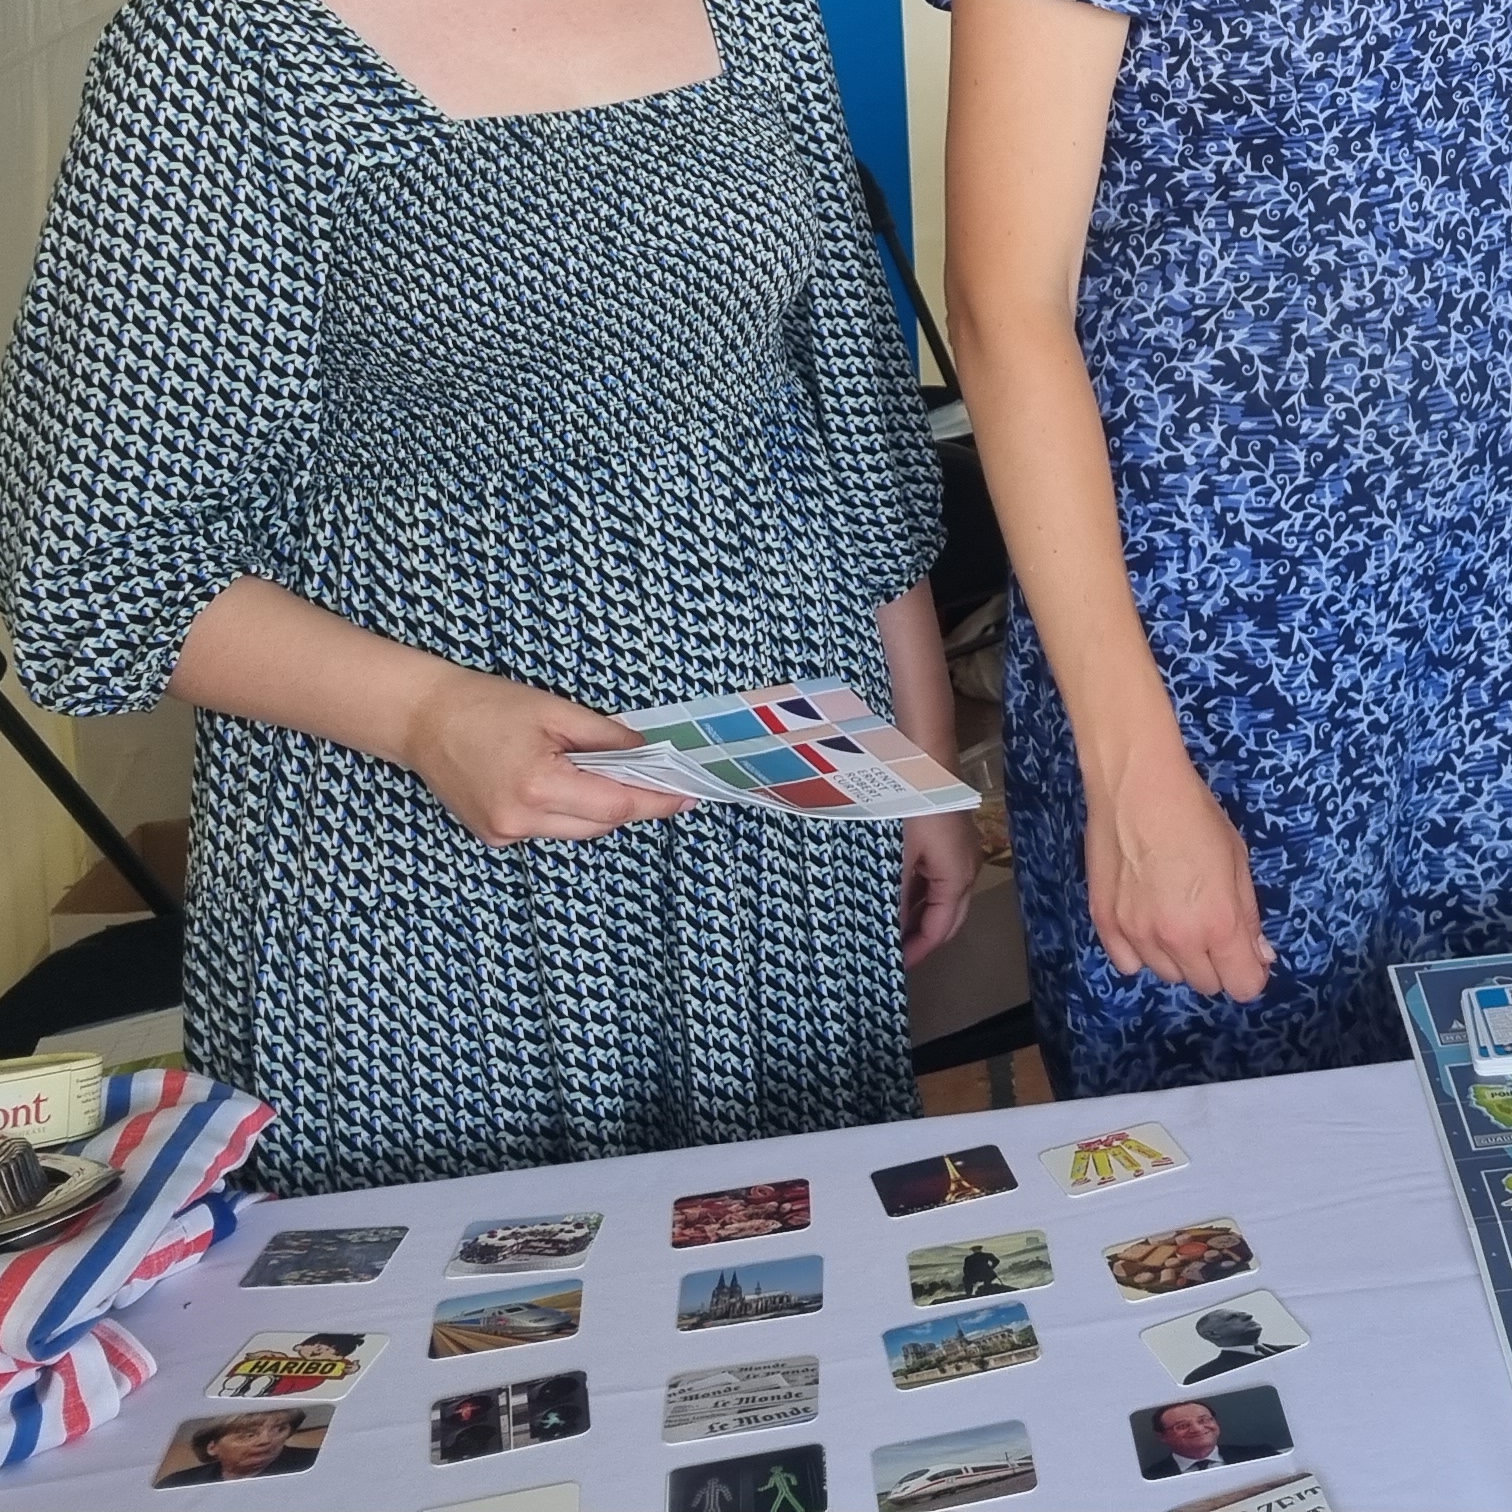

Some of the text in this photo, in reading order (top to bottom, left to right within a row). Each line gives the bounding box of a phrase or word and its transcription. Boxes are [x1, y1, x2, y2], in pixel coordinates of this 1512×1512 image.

[833, 774, 873, 803] CURTIUS
[846, 772, 883, 798] ROBERT
[857, 769, 888, 791] ERNST
[870, 766, 906, 792] CENTRE
[249, 1360, 337, 1375] HARIBO
[738, 1362, 788, 1373] Monde
[680, 1385, 742, 1403] Monde
[712, 1399, 732, 1409] Le
[734, 1390, 804, 1407] Monde
[705, 1421, 730, 1435] Le
[732, 1405, 814, 1429] Monde
[1256, 1486, 1323, 1512] ZEIT
